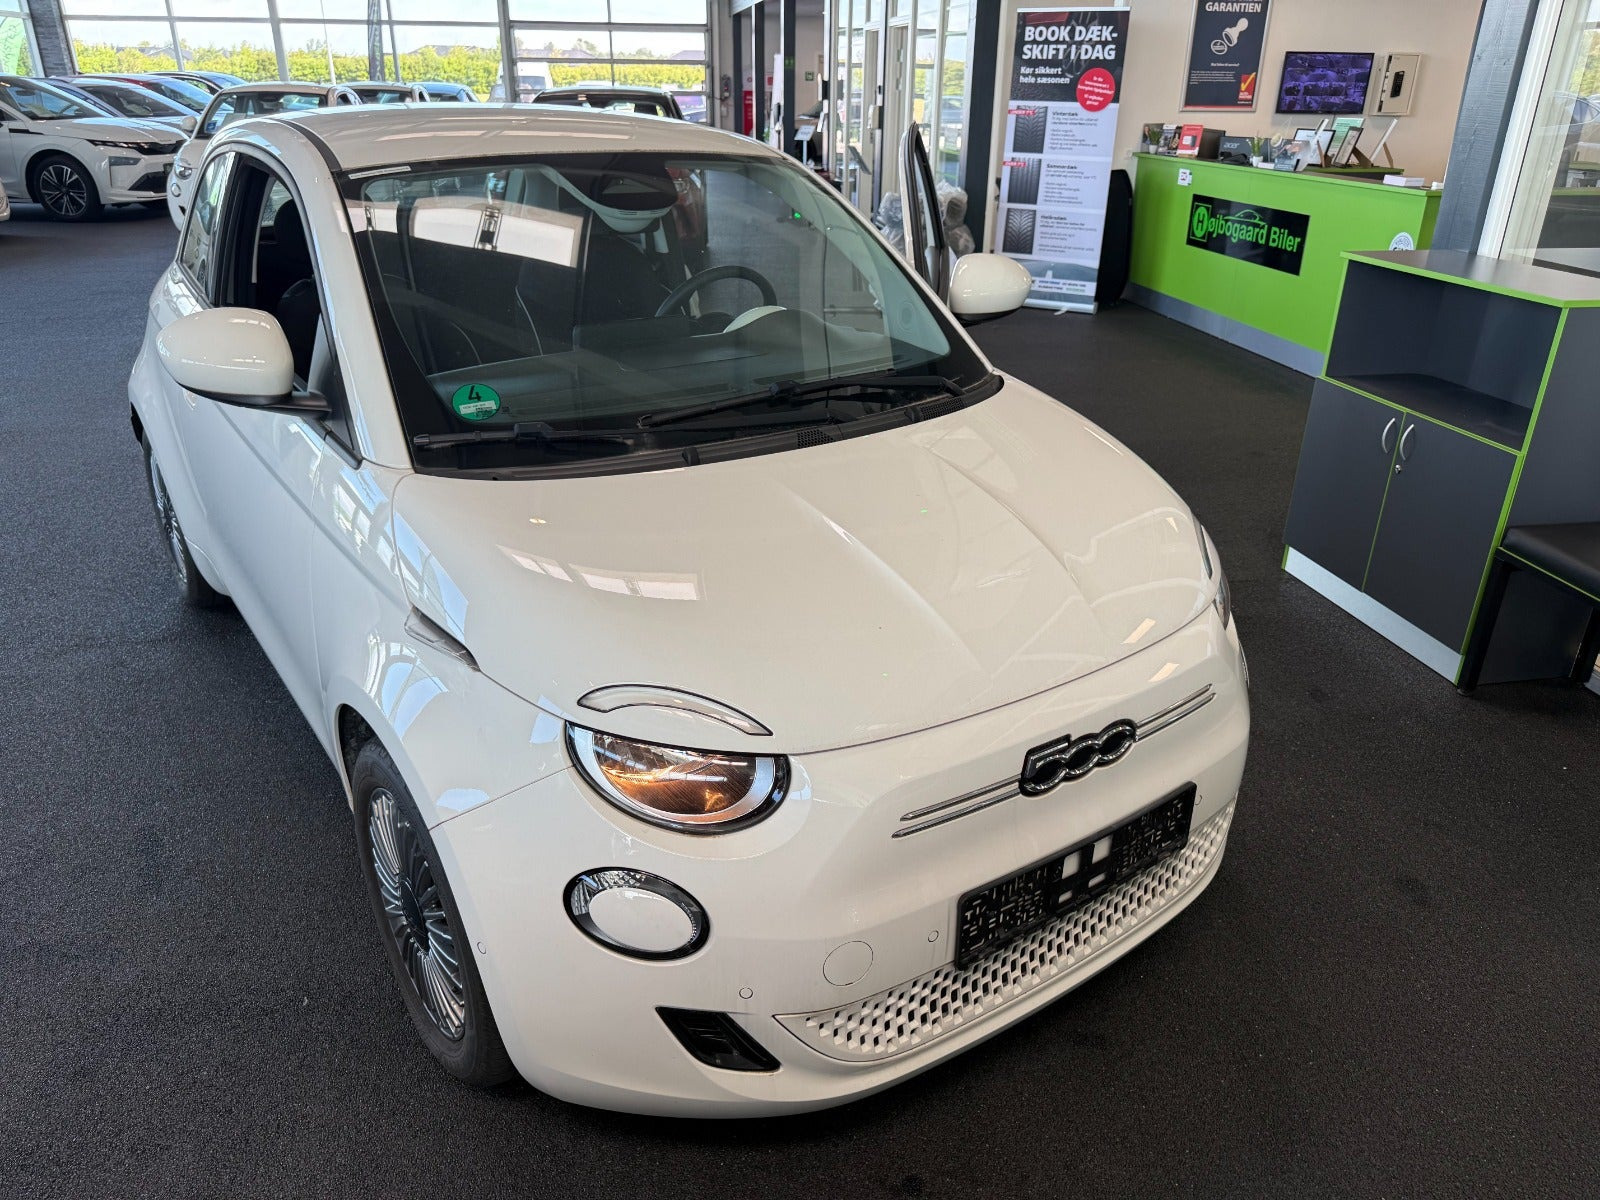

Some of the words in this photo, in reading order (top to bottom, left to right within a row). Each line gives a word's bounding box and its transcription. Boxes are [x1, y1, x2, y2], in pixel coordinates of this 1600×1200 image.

[1205, 2, 1261, 13] GARANTIEN
[1024, 26, 1071, 41] BOOK
[1074, 26, 1118, 41] DÆK-
[1022, 44, 1067, 59] SKIFT
[1070, 45, 1076, 59] I
[1080, 45, 1116, 60] DAG
[1020, 66, 1033, 74] Kør
[1034, 66, 1062, 74] sikkert
[1019, 75, 1035, 84] hele
[1036, 76, 1070, 84] sæsonen
[1269, 227, 1301, 252] Biler
[468, 385, 482, 402] 4
[1019, 719, 1137, 797] 500
